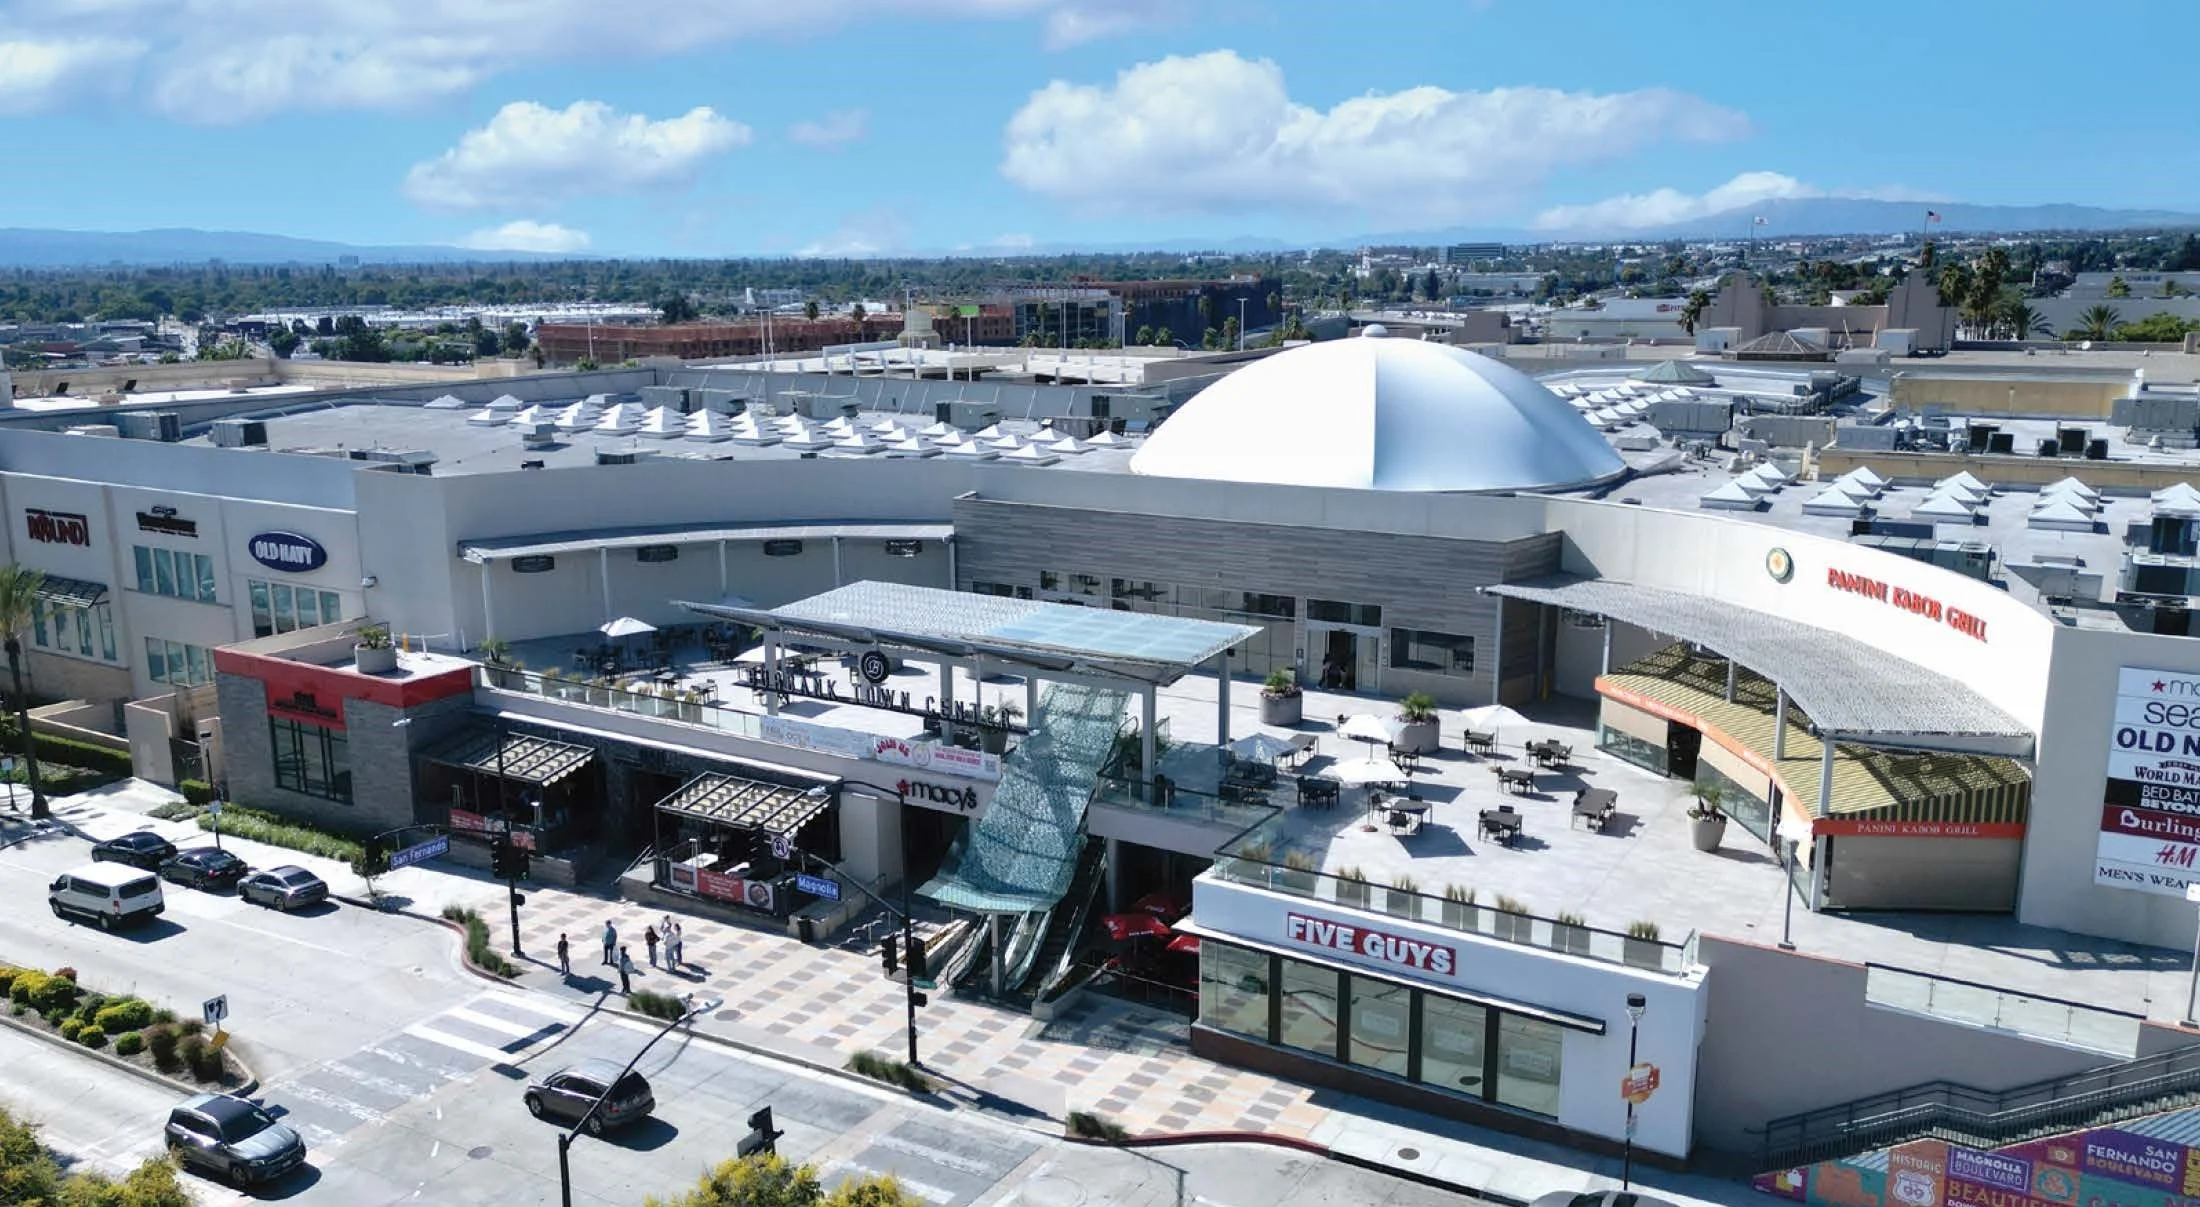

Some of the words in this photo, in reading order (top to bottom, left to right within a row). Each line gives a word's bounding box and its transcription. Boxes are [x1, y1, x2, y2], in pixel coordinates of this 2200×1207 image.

[255, 540, 279, 560] OLD
[279, 543, 312, 566] NAVY
[1827, 567, 1888, 603] PANINI
[1946, 606, 1988, 642] GRILL
[854, 682, 911, 710] TOWN
[925, 696, 1010, 729] CENTER
[2117, 727, 2175, 752] OLD
[2135, 766, 2181, 782] WORLD
[911, 782, 977, 811] macy's
[2142, 784, 2170, 799] BED
[1857, 823, 1896, 833] PANINI
[1945, 826, 1978, 834] GRILL
[392, 853, 408, 866] San
[410, 841, 446, 862] Fernando
[2099, 866, 2144, 882] MEN'S
[798, 877, 837, 896] Magnolia
[1288, 916, 1355, 952] FIVE
[1363, 934, 1451, 974] GUYS
[1891, 1153, 1941, 1174] HISTORIC
[1956, 1151, 2022, 1174] MAGNOLIA
[2087, 1144, 2176, 1173] FERNANDO
[2145, 1145, 2178, 1161] SAN
[1955, 1161, 2022, 1185] BOULEVARD
[2086, 1156, 2175, 1184] BOULEVARD
